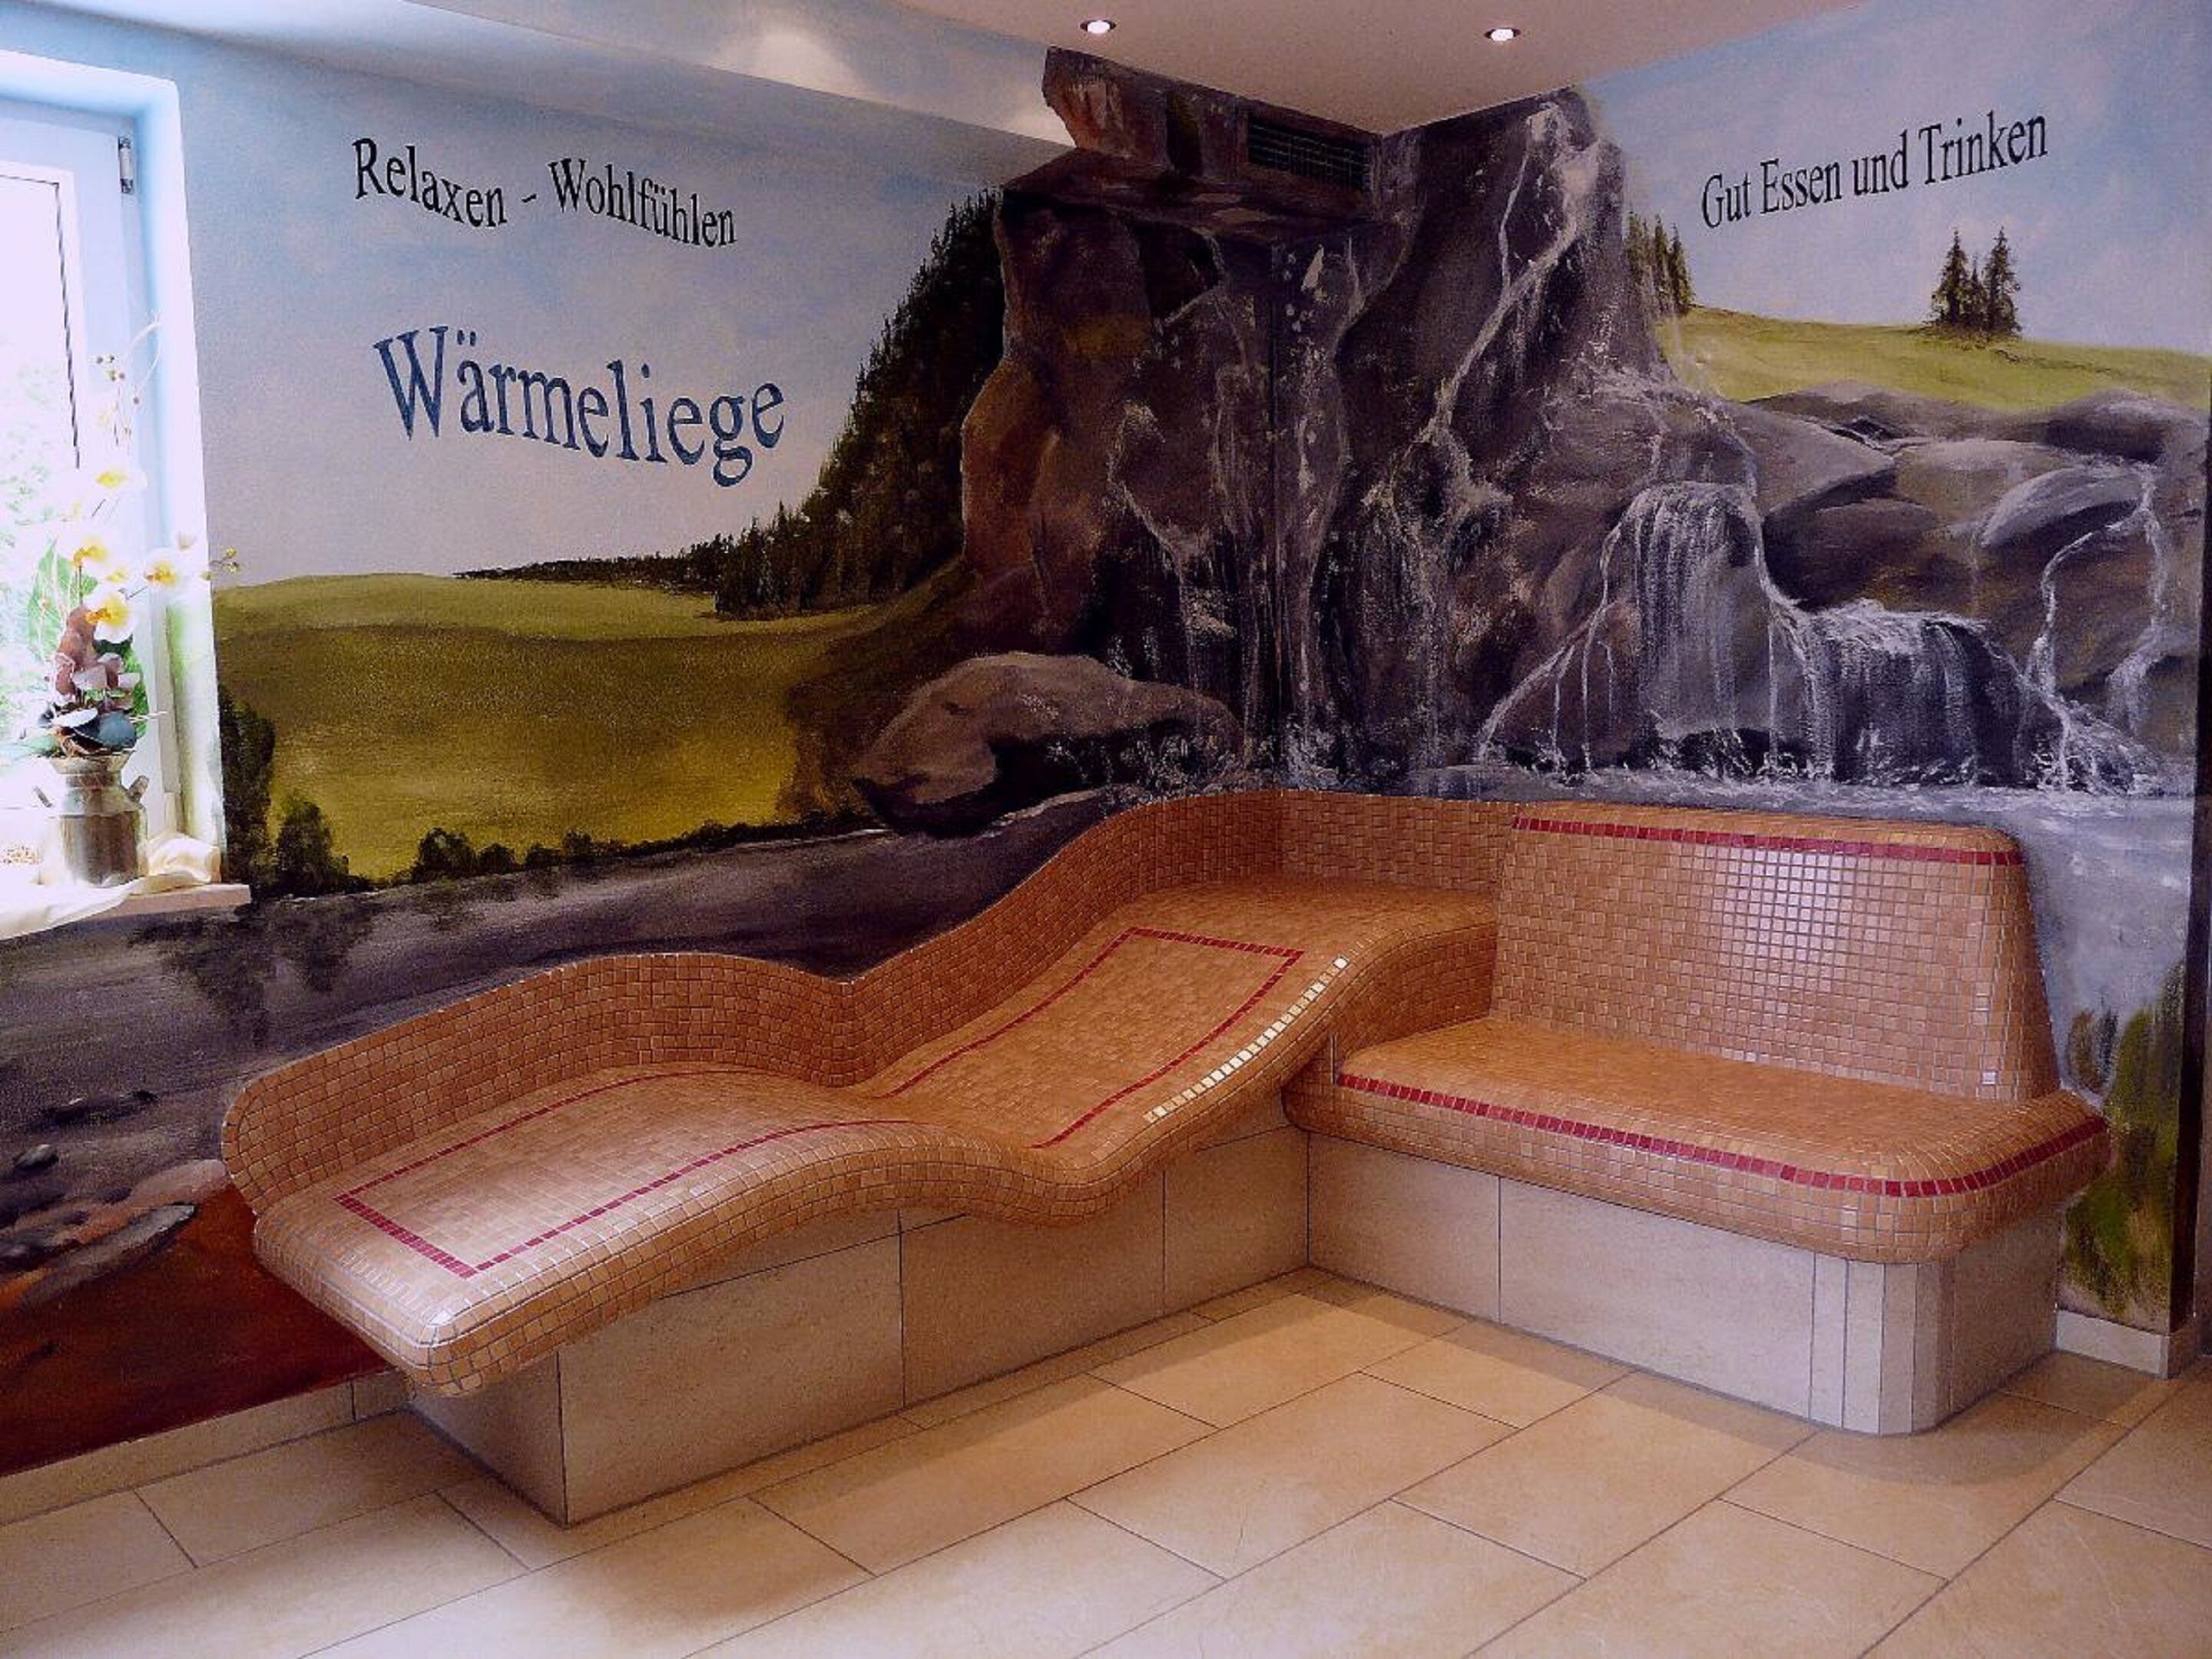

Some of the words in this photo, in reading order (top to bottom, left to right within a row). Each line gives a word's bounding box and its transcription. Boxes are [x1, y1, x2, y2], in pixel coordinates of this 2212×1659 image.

[351, 137, 508, 227] Relaxen
[522, 194, 538, 204] -
[548, 157, 737, 247] Wohlfühlen
[1702, 172, 1751, 228] Gut
[1760, 158, 1842, 214] Essen
[1852, 129, 1909, 196] und
[1919, 110, 2048, 185] Trinken
[373, 326, 785, 487] Wärmeliege
